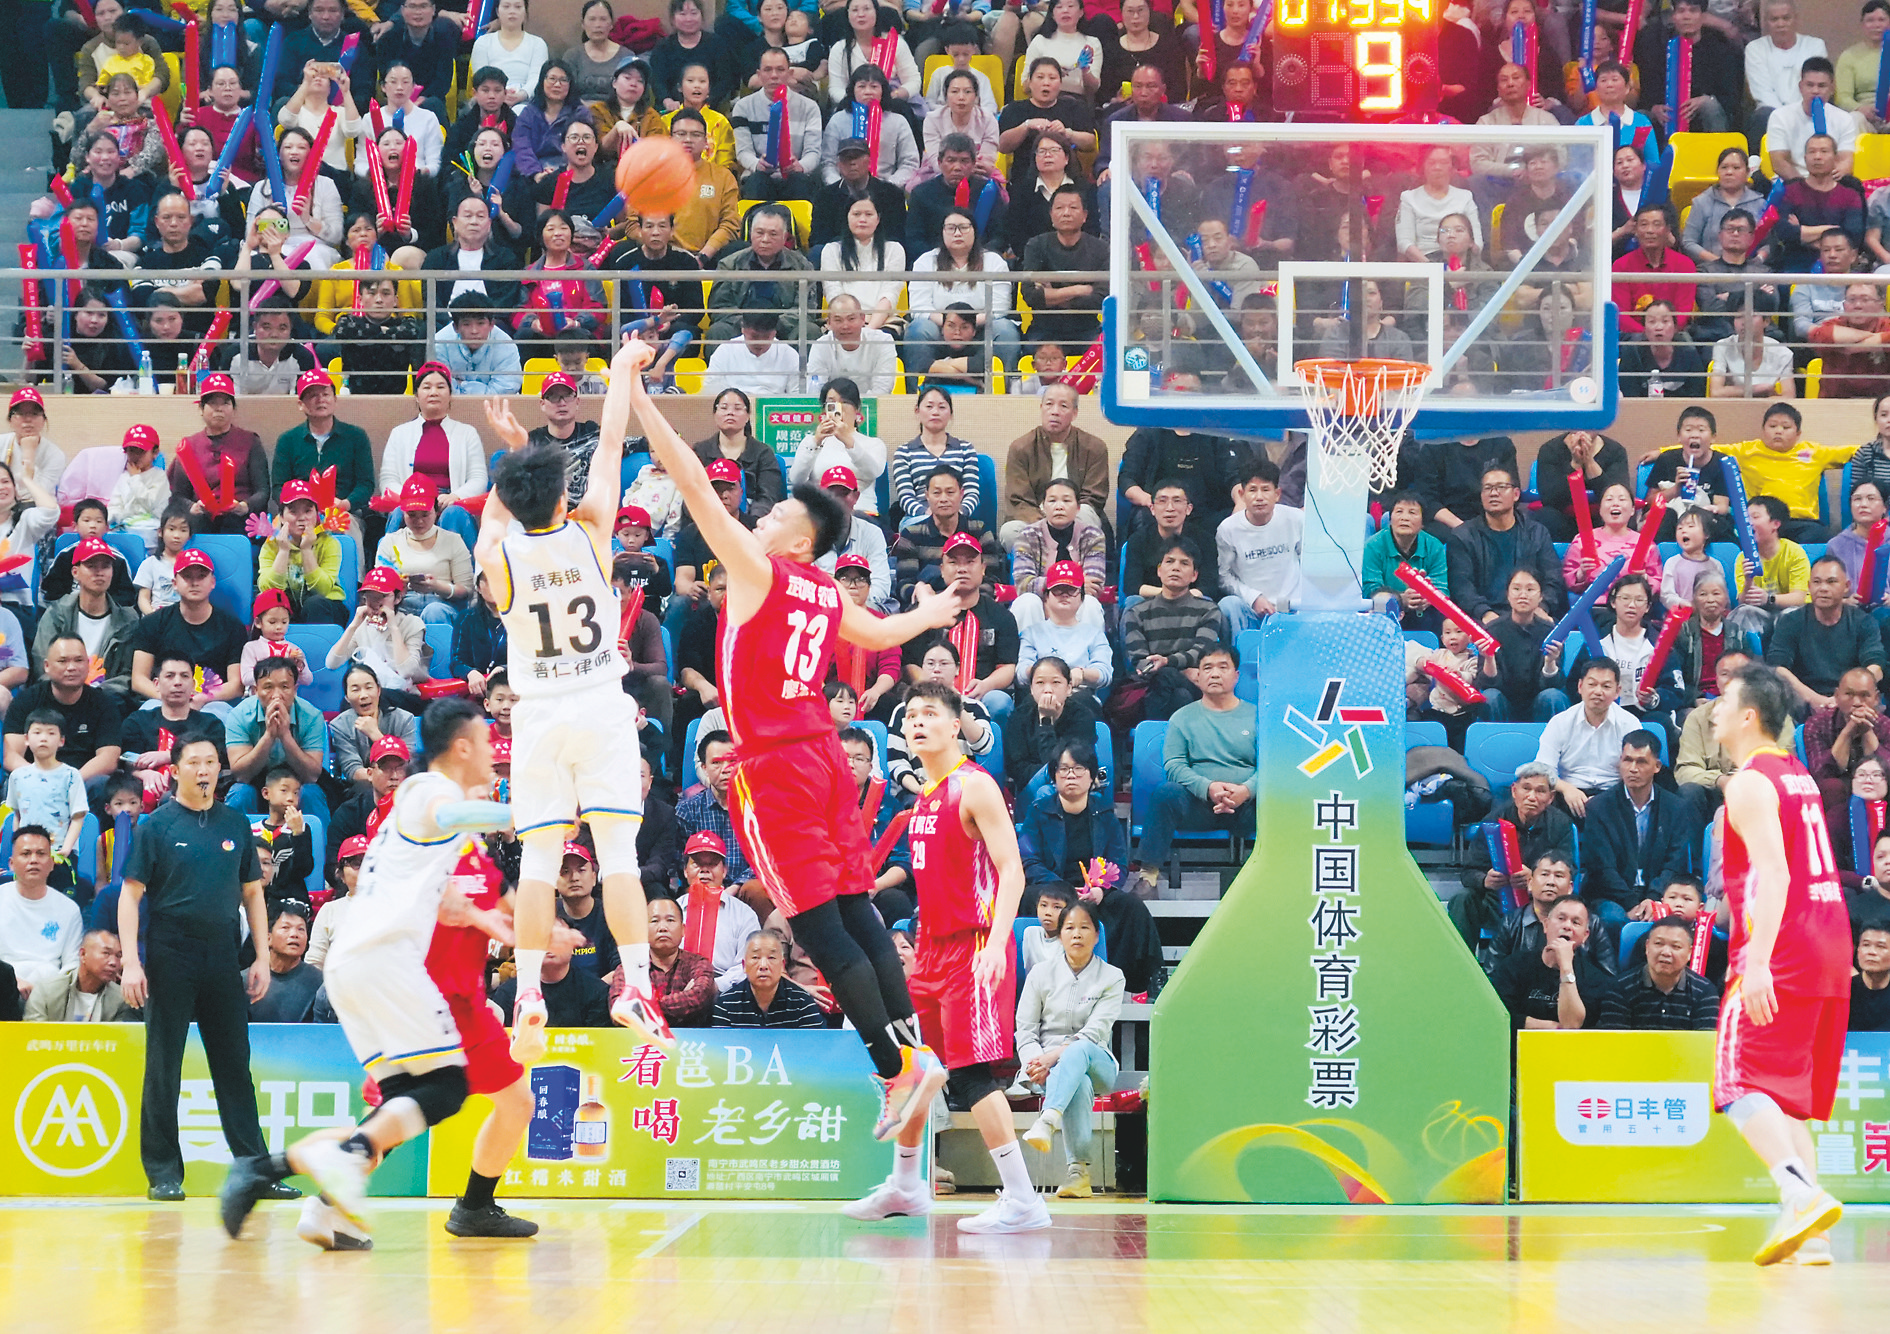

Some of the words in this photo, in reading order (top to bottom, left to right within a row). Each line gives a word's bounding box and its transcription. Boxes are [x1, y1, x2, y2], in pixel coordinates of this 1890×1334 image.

[1356, 31, 1403, 109] 9
[771, 413, 813, 423] 文明健康
[530, 567, 582, 592] 黄寿银
[528, 594, 603, 658] 13
[784, 609, 829, 682] 13
[533, 649, 612, 679] 善仁律师
[912, 840, 926, 870] 29
[1306, 791, 1360, 1107] 中国体育彩票
[1616, 1098, 1686, 1120] 日丰管
[1578, 1124, 1686, 1133] 管用五十年
[505, 1169, 627, 1187] 红糯米甜酒
